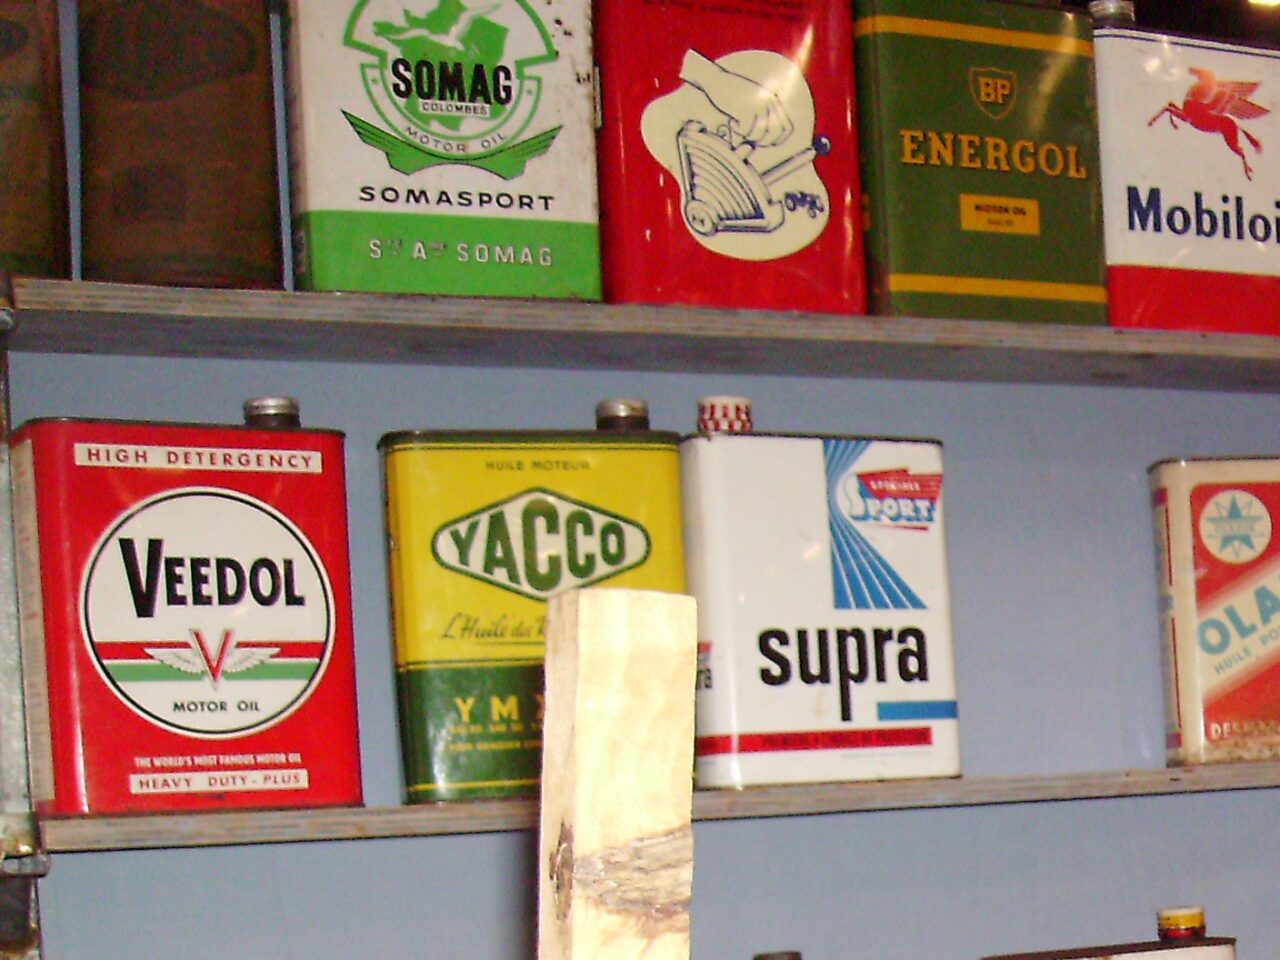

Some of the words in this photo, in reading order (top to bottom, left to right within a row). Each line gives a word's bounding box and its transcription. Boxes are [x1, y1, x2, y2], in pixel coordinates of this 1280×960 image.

[391, 57, 513, 106] SOMAG
[979, 76, 1011, 104] BP
[422, 102, 489, 116] COLOMBES
[405, 126, 467, 153] MOTOR
[480, 132, 508, 149] OIL
[900, 129, 1088, 179] ENERGOL
[359, 186, 555, 211] SOMASPORT
[457, 243, 552, 267] SOMAG
[87, 447, 149, 464] HIGH
[166, 449, 314, 469] DETERGENCY
[485, 460, 526, 472] HUILE
[532, 460, 591, 472] MOTEUR
[845, 474, 935, 522] SPORT
[449, 496, 627, 593] YACCO
[118, 537, 306, 619] VEEDOL
[758, 626, 929, 722] supra
[1213, 646, 1254, 675] HUILE
[173, 701, 228, 713] MOTOR
[237, 700, 261, 712] OIL
[219, 753, 255, 766] FAMOUS
[256, 752, 286, 764] MOTOR
[287, 752, 302, 763] OIL
[139, 776, 193, 790] HEAVY
